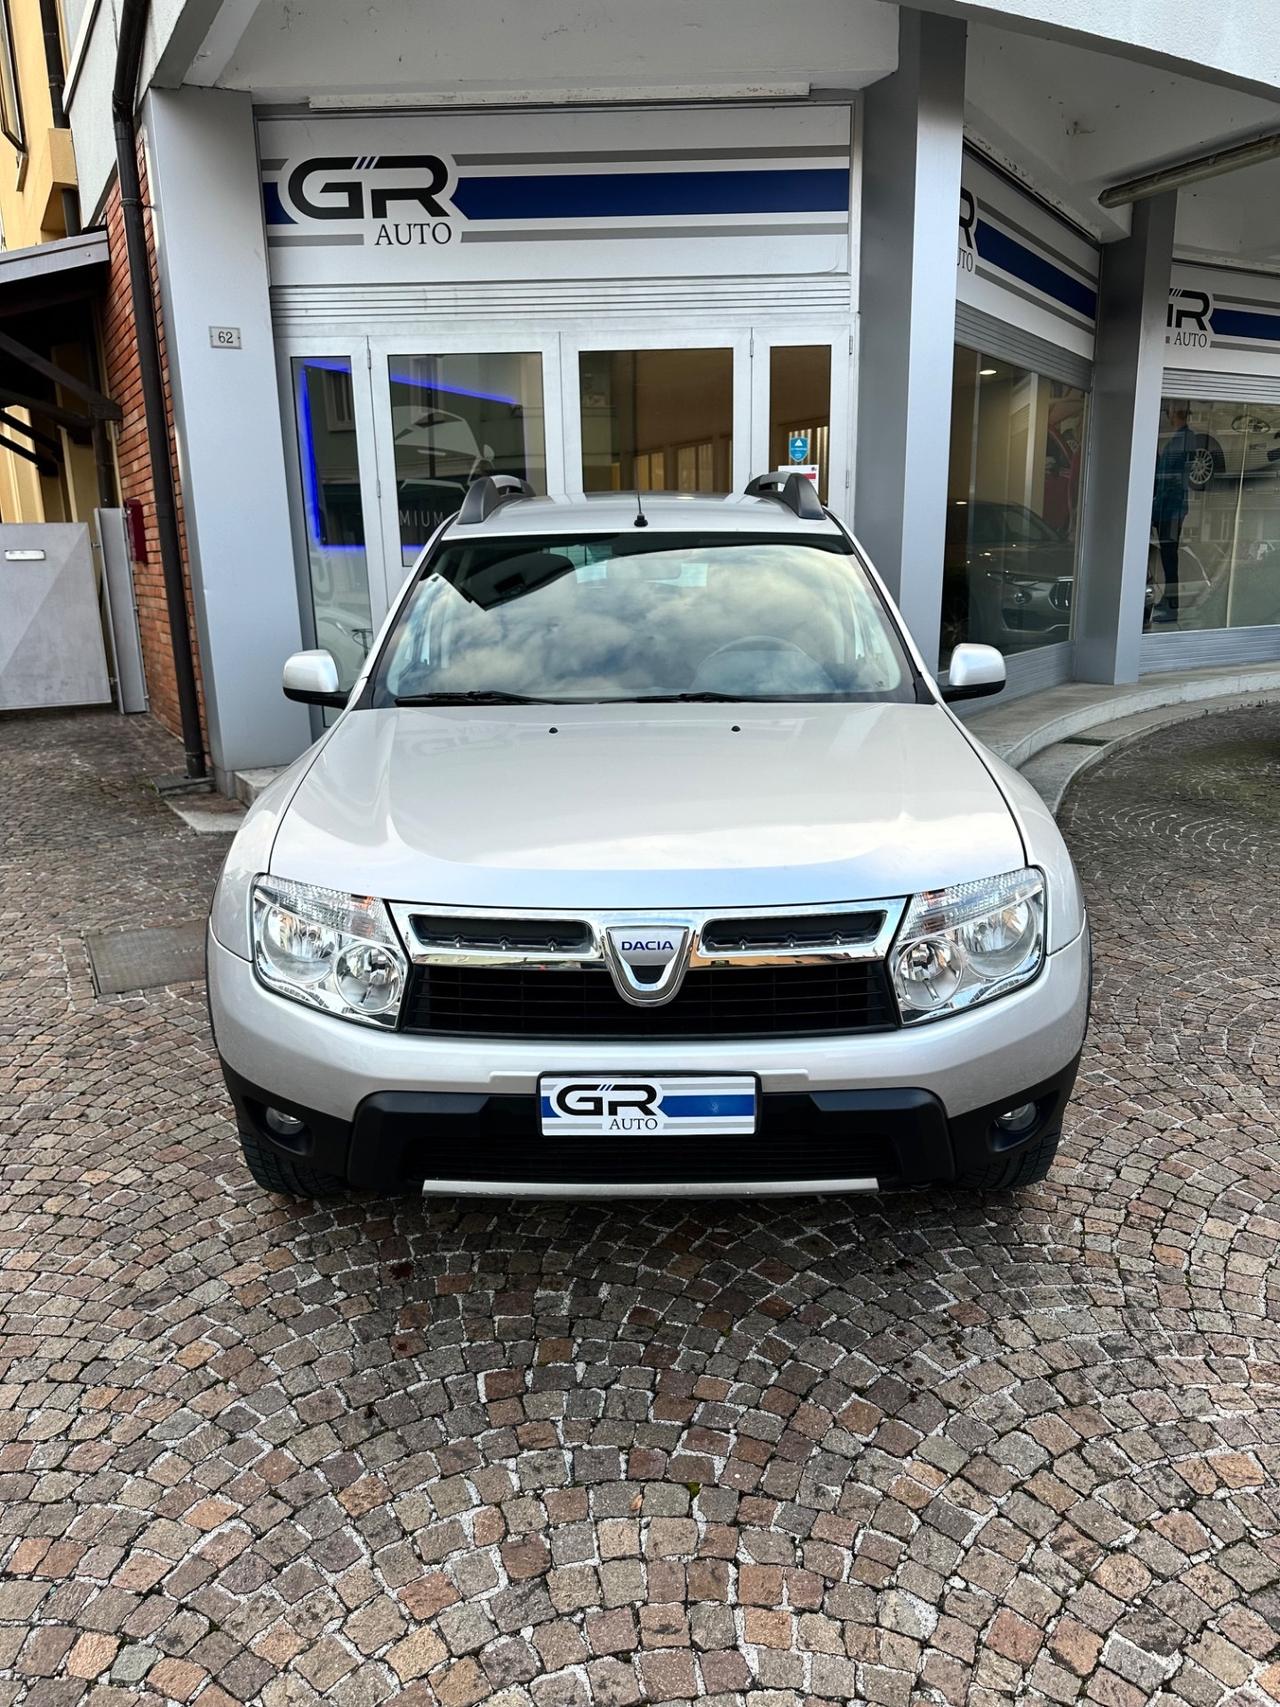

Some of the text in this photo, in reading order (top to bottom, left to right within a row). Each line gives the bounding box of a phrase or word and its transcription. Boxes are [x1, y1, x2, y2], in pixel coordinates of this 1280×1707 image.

[288, 155, 451, 220] GR
[374, 222, 452, 245] AUTO
[218, 330, 234, 344] 62
[1173, 332, 1207, 348] AUTO
[621, 940, 674, 951] DACIA
[556, 1084, 658, 1117] GR
[609, 1117, 658, 1131] AUTO
